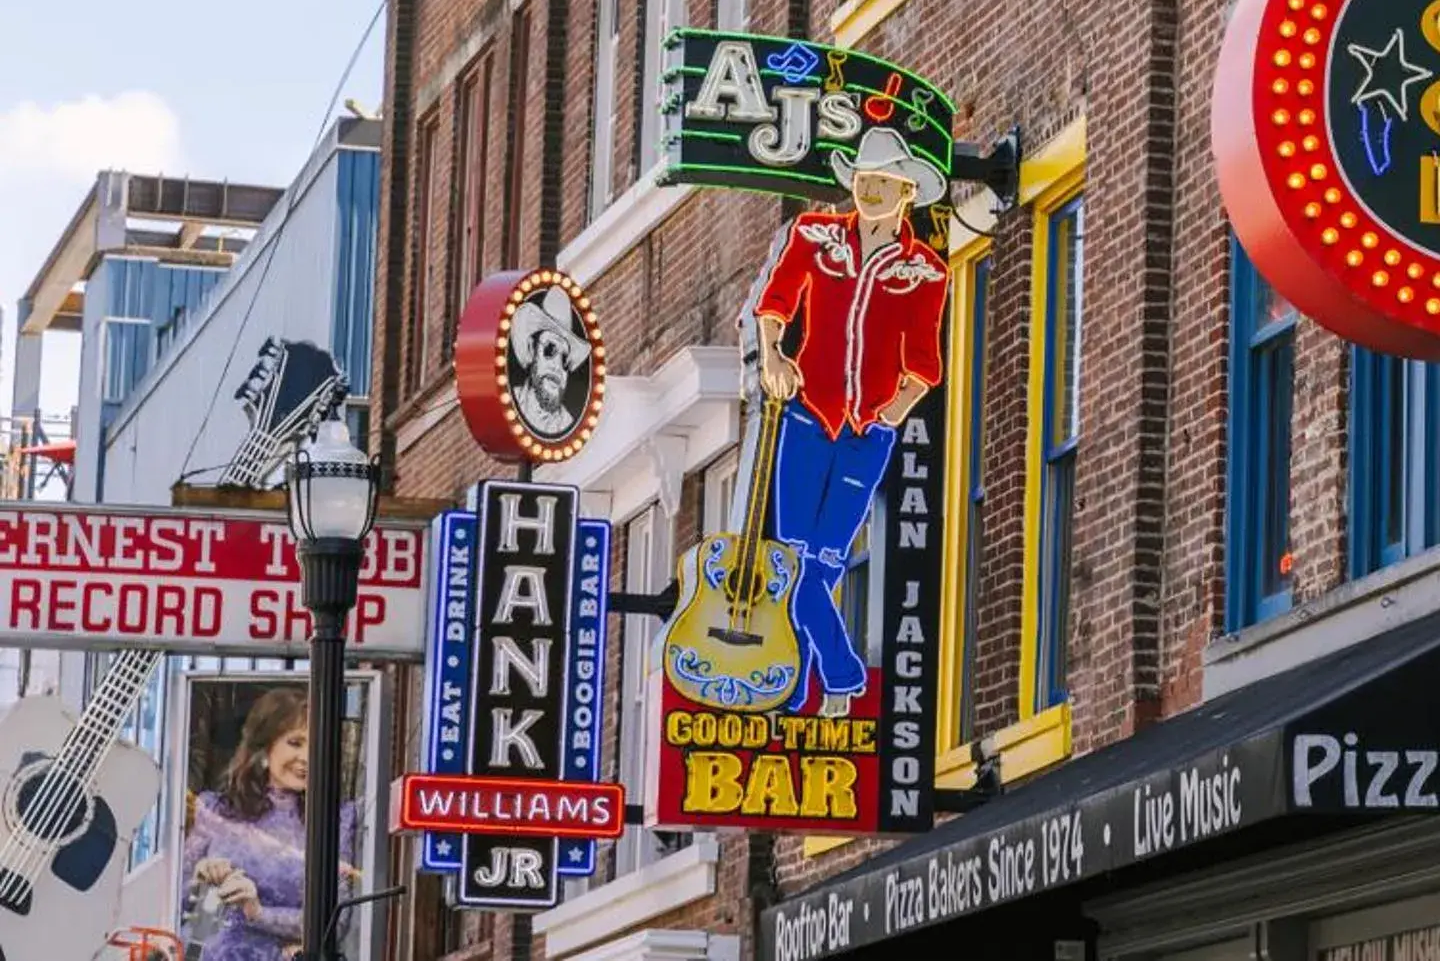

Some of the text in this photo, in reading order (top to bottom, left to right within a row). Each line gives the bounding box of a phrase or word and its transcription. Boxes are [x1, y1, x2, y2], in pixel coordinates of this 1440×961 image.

[260, 524, 416, 583] TBB
[9, 578, 387, 643] RECORD SHP
[440, 545, 469, 743] EAT DRINK
[488, 493, 558, 770] HANK
[890, 417, 931, 818] ALAN JACKSON
[573, 553, 600, 749] BOOGIE BAR
[666, 712, 877, 752] GOOD TIME
[419, 789, 611, 825] WILLIAMS
[683, 750, 858, 820] BAR
[474, 846, 545, 888] JR
[775, 755, 1242, 961] Rooftop Bar Pizza Bakers Since 1974 Live Music
